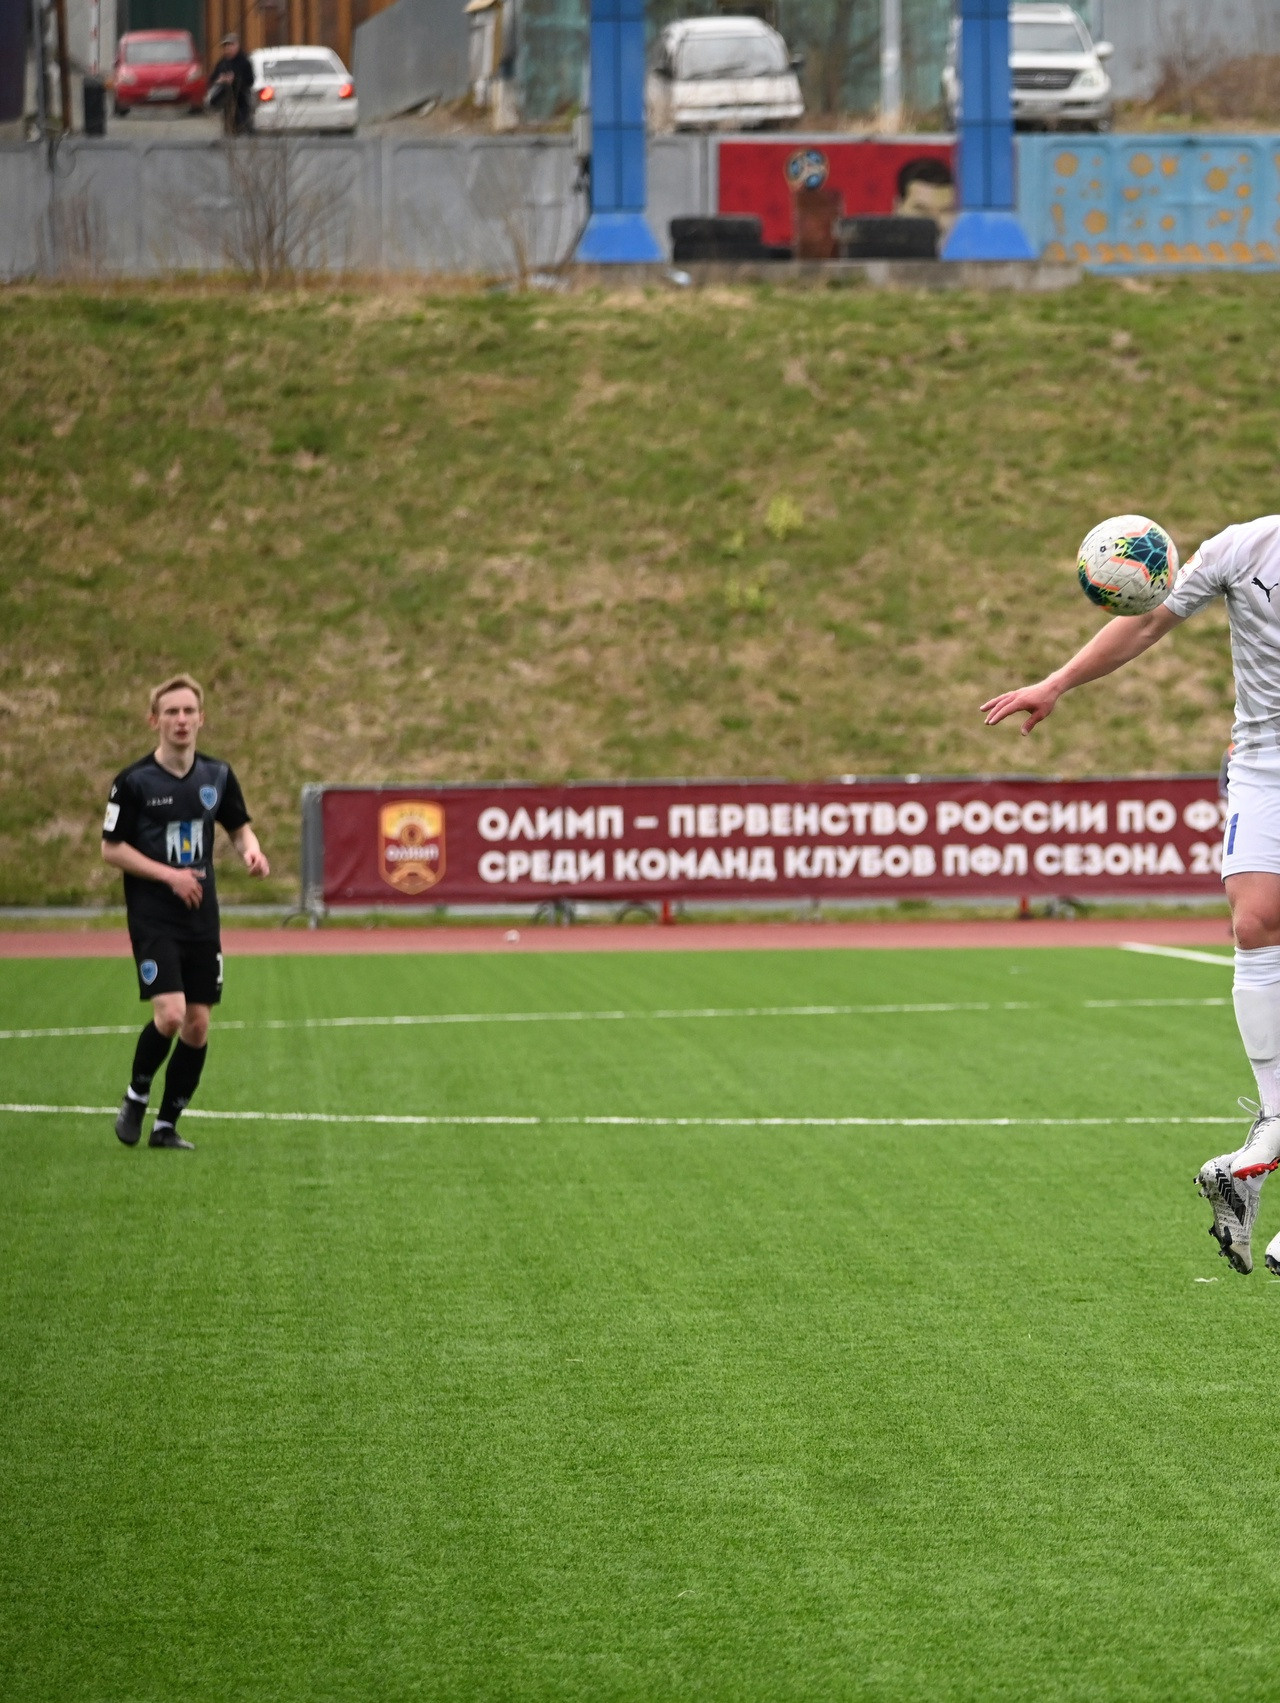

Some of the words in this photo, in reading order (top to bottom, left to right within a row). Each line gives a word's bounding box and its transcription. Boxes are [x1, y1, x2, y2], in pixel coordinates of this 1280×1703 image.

[477, 806, 624, 841] ОЛИМП
[667, 801, 928, 838] ПЕРВЕНСТВО
[936, 799, 1108, 835] РОССИИ
[1116, 799, 1177, 834] ПО
[477, 849, 606, 885] СРЕДИ
[612, 847, 778, 882] КОМАНД
[783, 844, 937, 879] КЛУБОВ
[942, 843, 1029, 877] ПФЛ
[1033, 841, 1186, 876] СЕЗОНА
